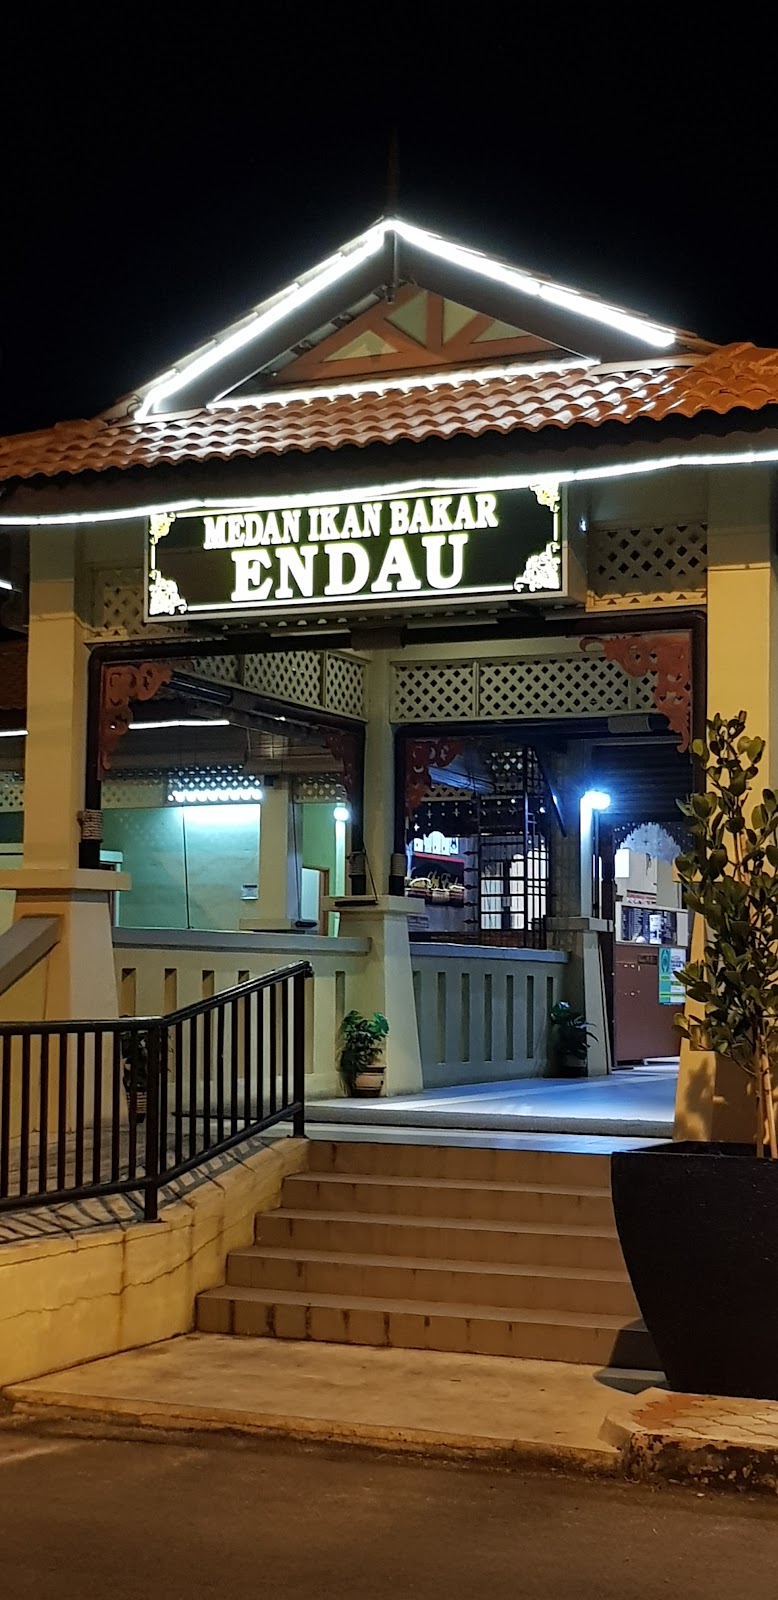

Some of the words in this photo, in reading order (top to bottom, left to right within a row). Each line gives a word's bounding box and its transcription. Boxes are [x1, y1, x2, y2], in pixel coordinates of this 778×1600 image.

[203, 509, 301, 549] MEDAN
[308, 503, 382, 540] IKAN
[389, 493, 499, 535] BAKAR
[230, 534, 469, 602] ENDAU
